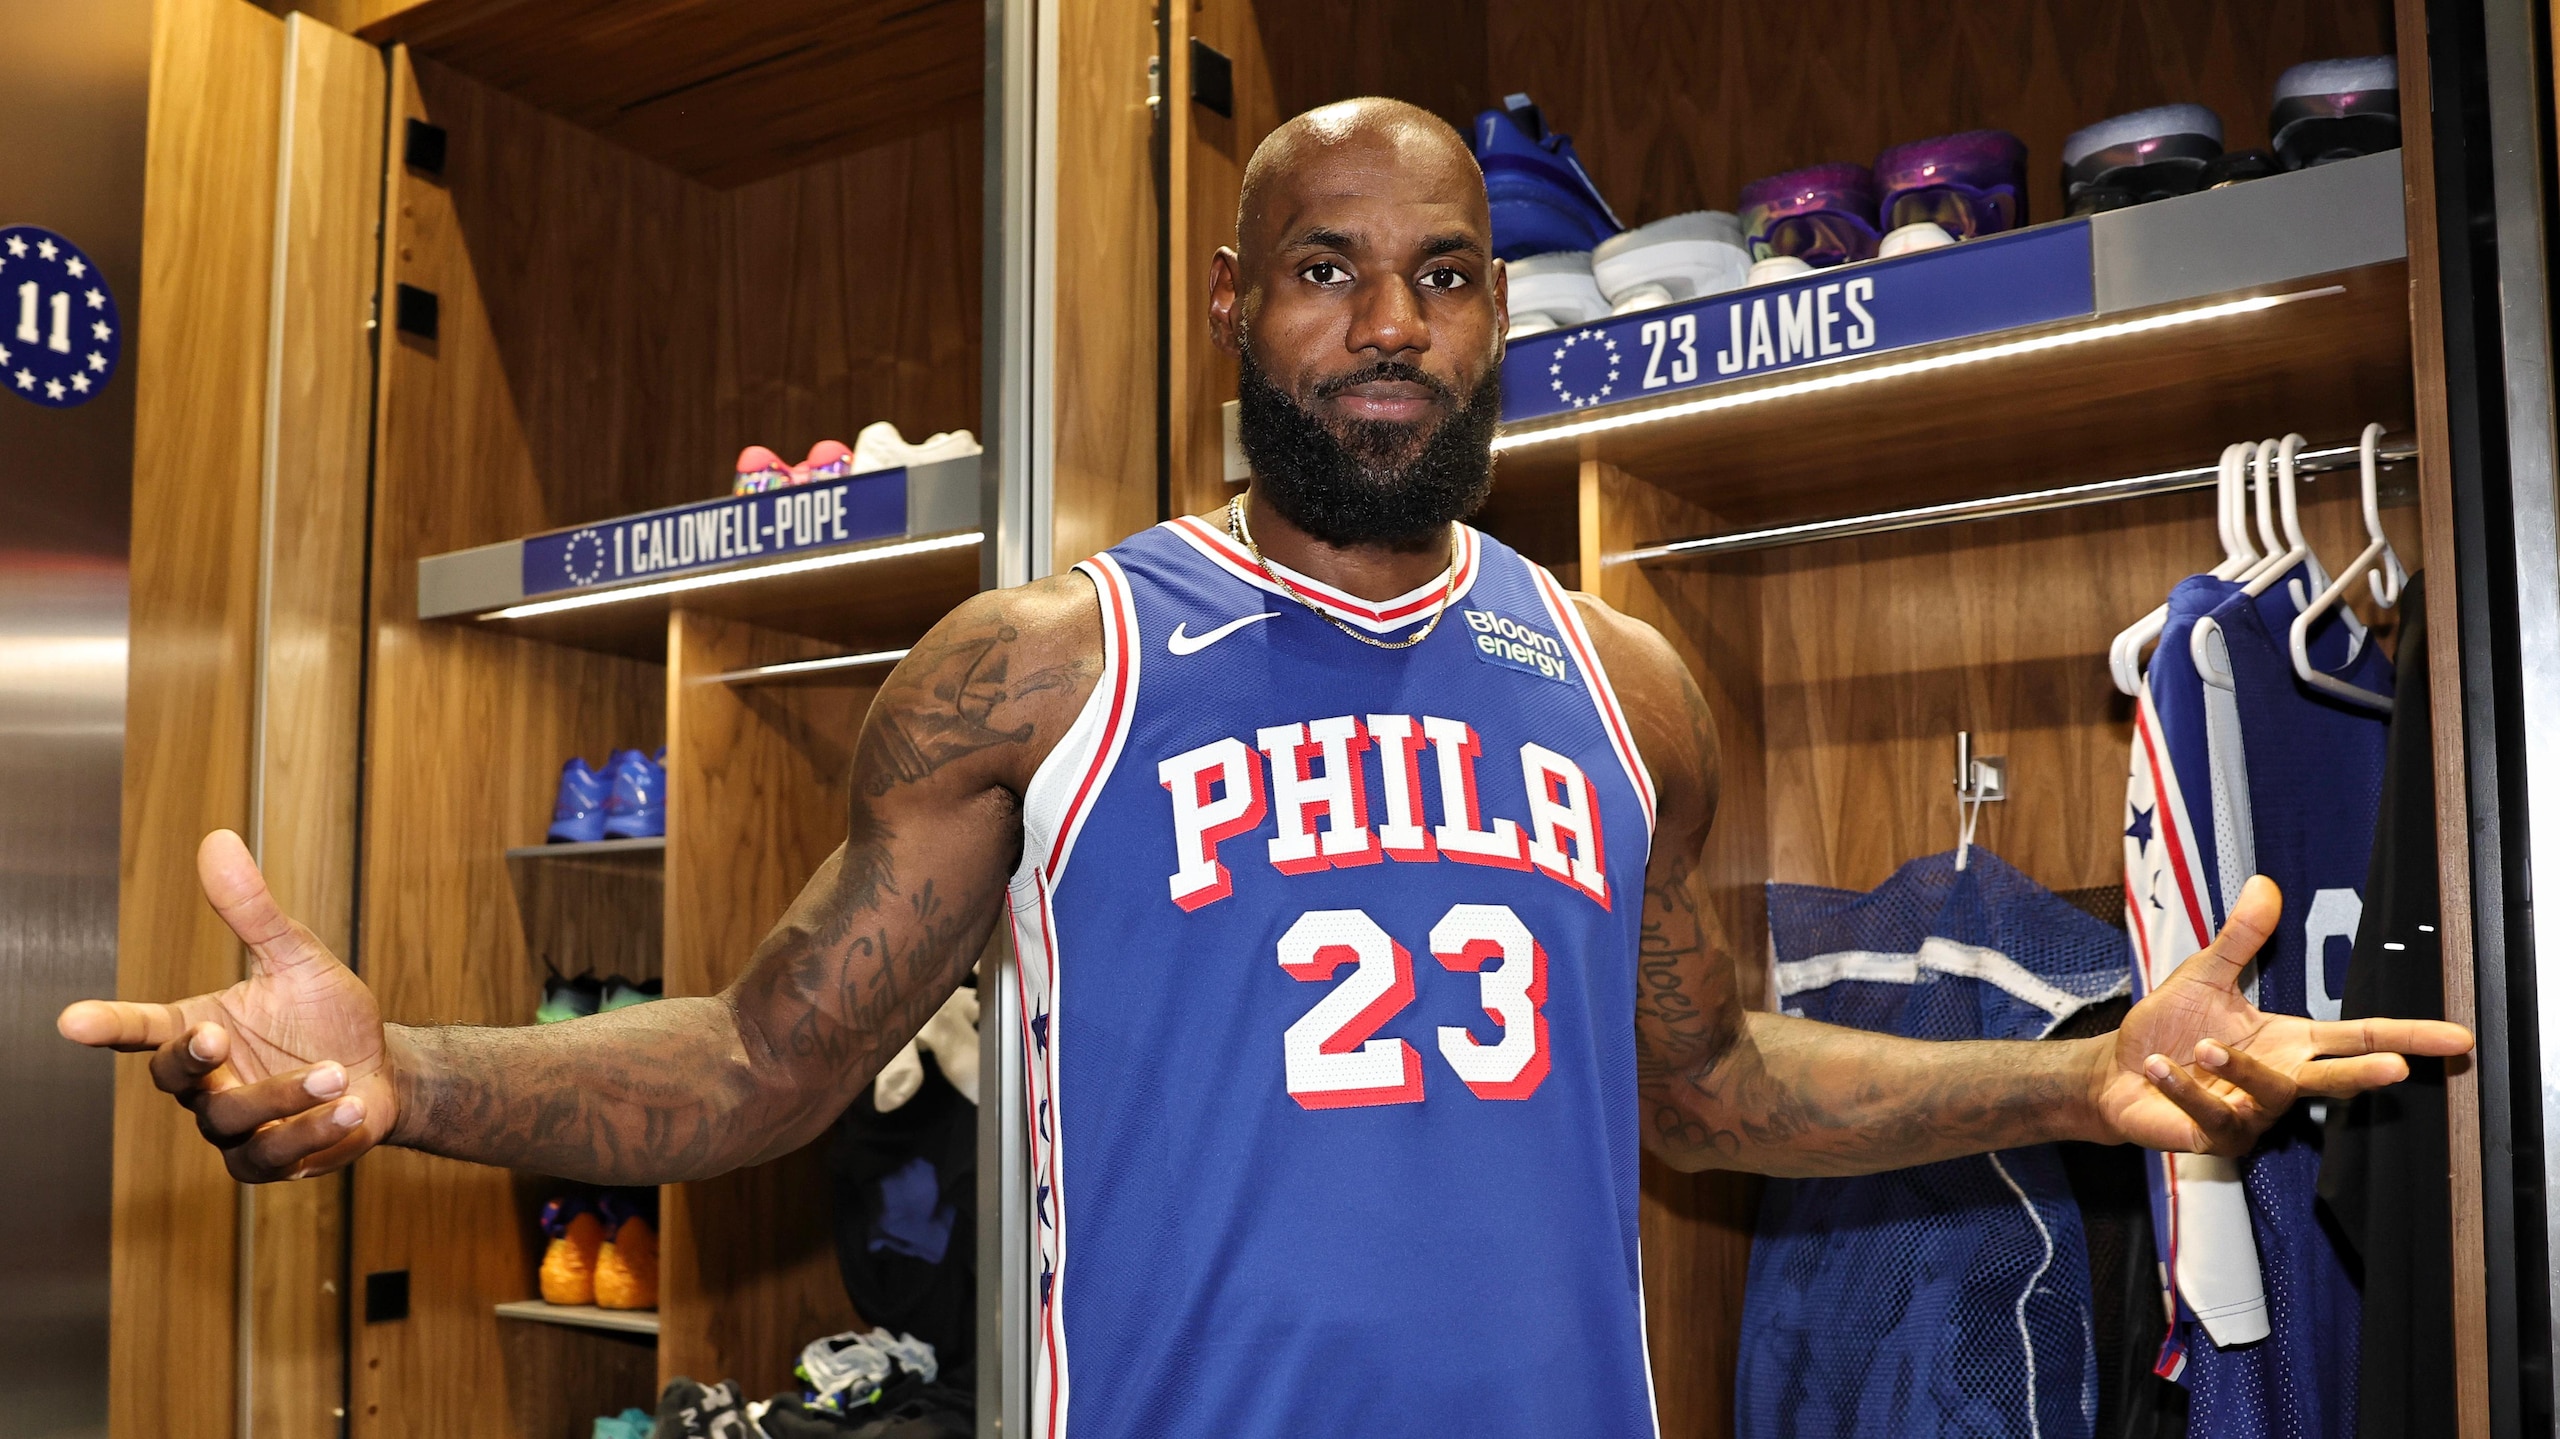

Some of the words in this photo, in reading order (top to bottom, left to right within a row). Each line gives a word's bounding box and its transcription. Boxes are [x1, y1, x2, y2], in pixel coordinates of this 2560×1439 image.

[16, 280, 71, 355] 11
[1641, 314, 1698, 390] 23
[1716, 277, 1876, 376] JAMES
[613, 526, 624, 576] 1
[631, 486, 849, 574] CALDWELL-POPE
[1463, 609, 1563, 658] Bloom
[1476, 634, 1566, 680] energy
[1158, 713, 1612, 913] PHILA
[1276, 903, 1552, 1111] 23
